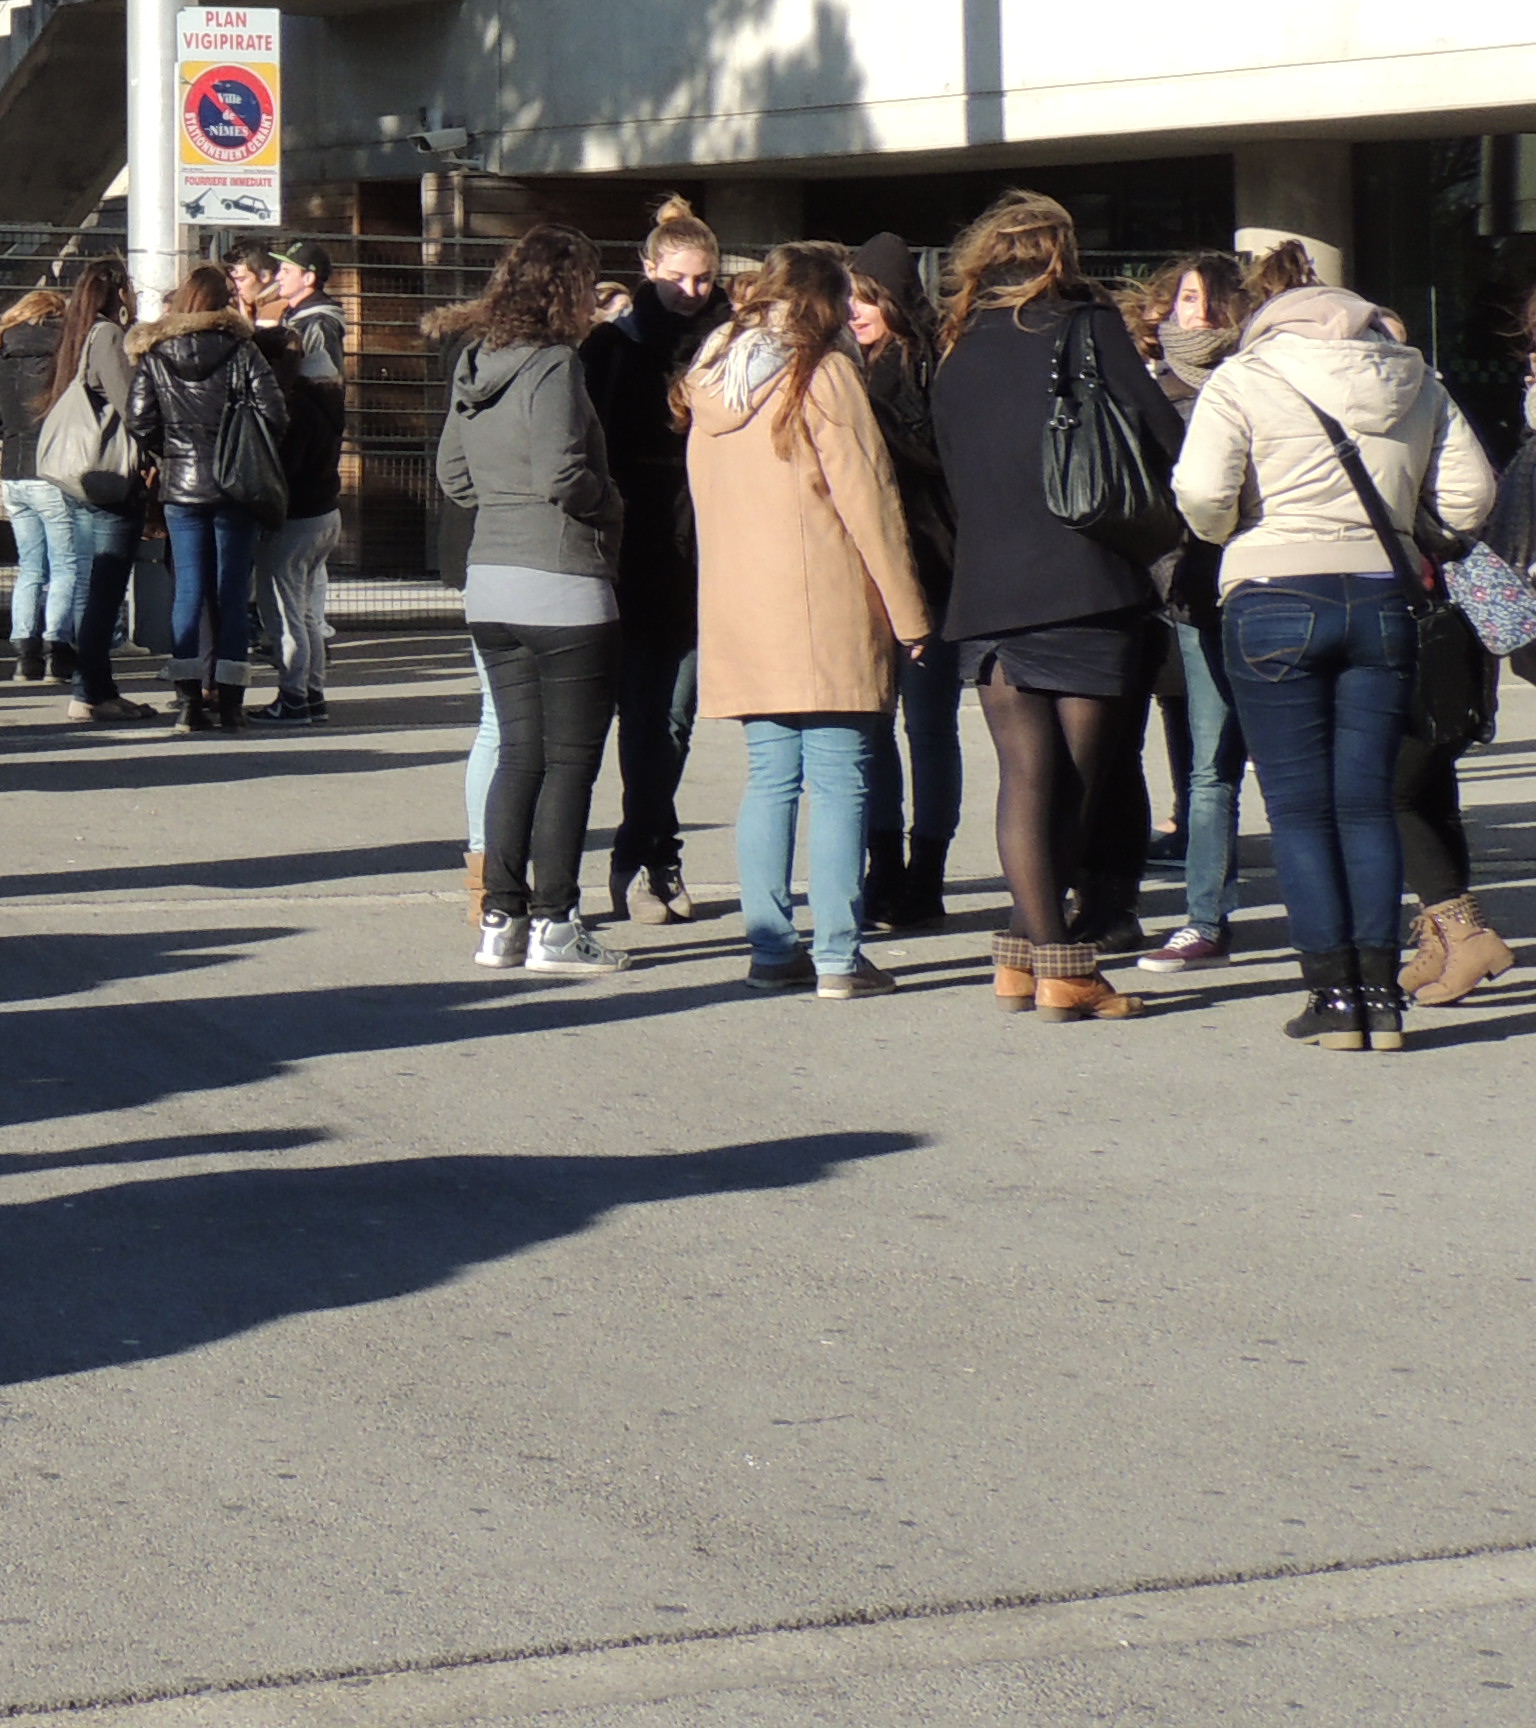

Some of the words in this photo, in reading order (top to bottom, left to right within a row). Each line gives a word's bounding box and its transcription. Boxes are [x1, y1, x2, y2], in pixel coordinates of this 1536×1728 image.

[205, 11, 247, 28] PLAN
[183, 32, 272, 51] VIGIPIRATE
[217, 93, 243, 104] Ville
[222, 109, 235, 120] de
[185, 112, 248, 160] STATIONNEMENT
[230, 178, 273, 187] IMMEDIATE
